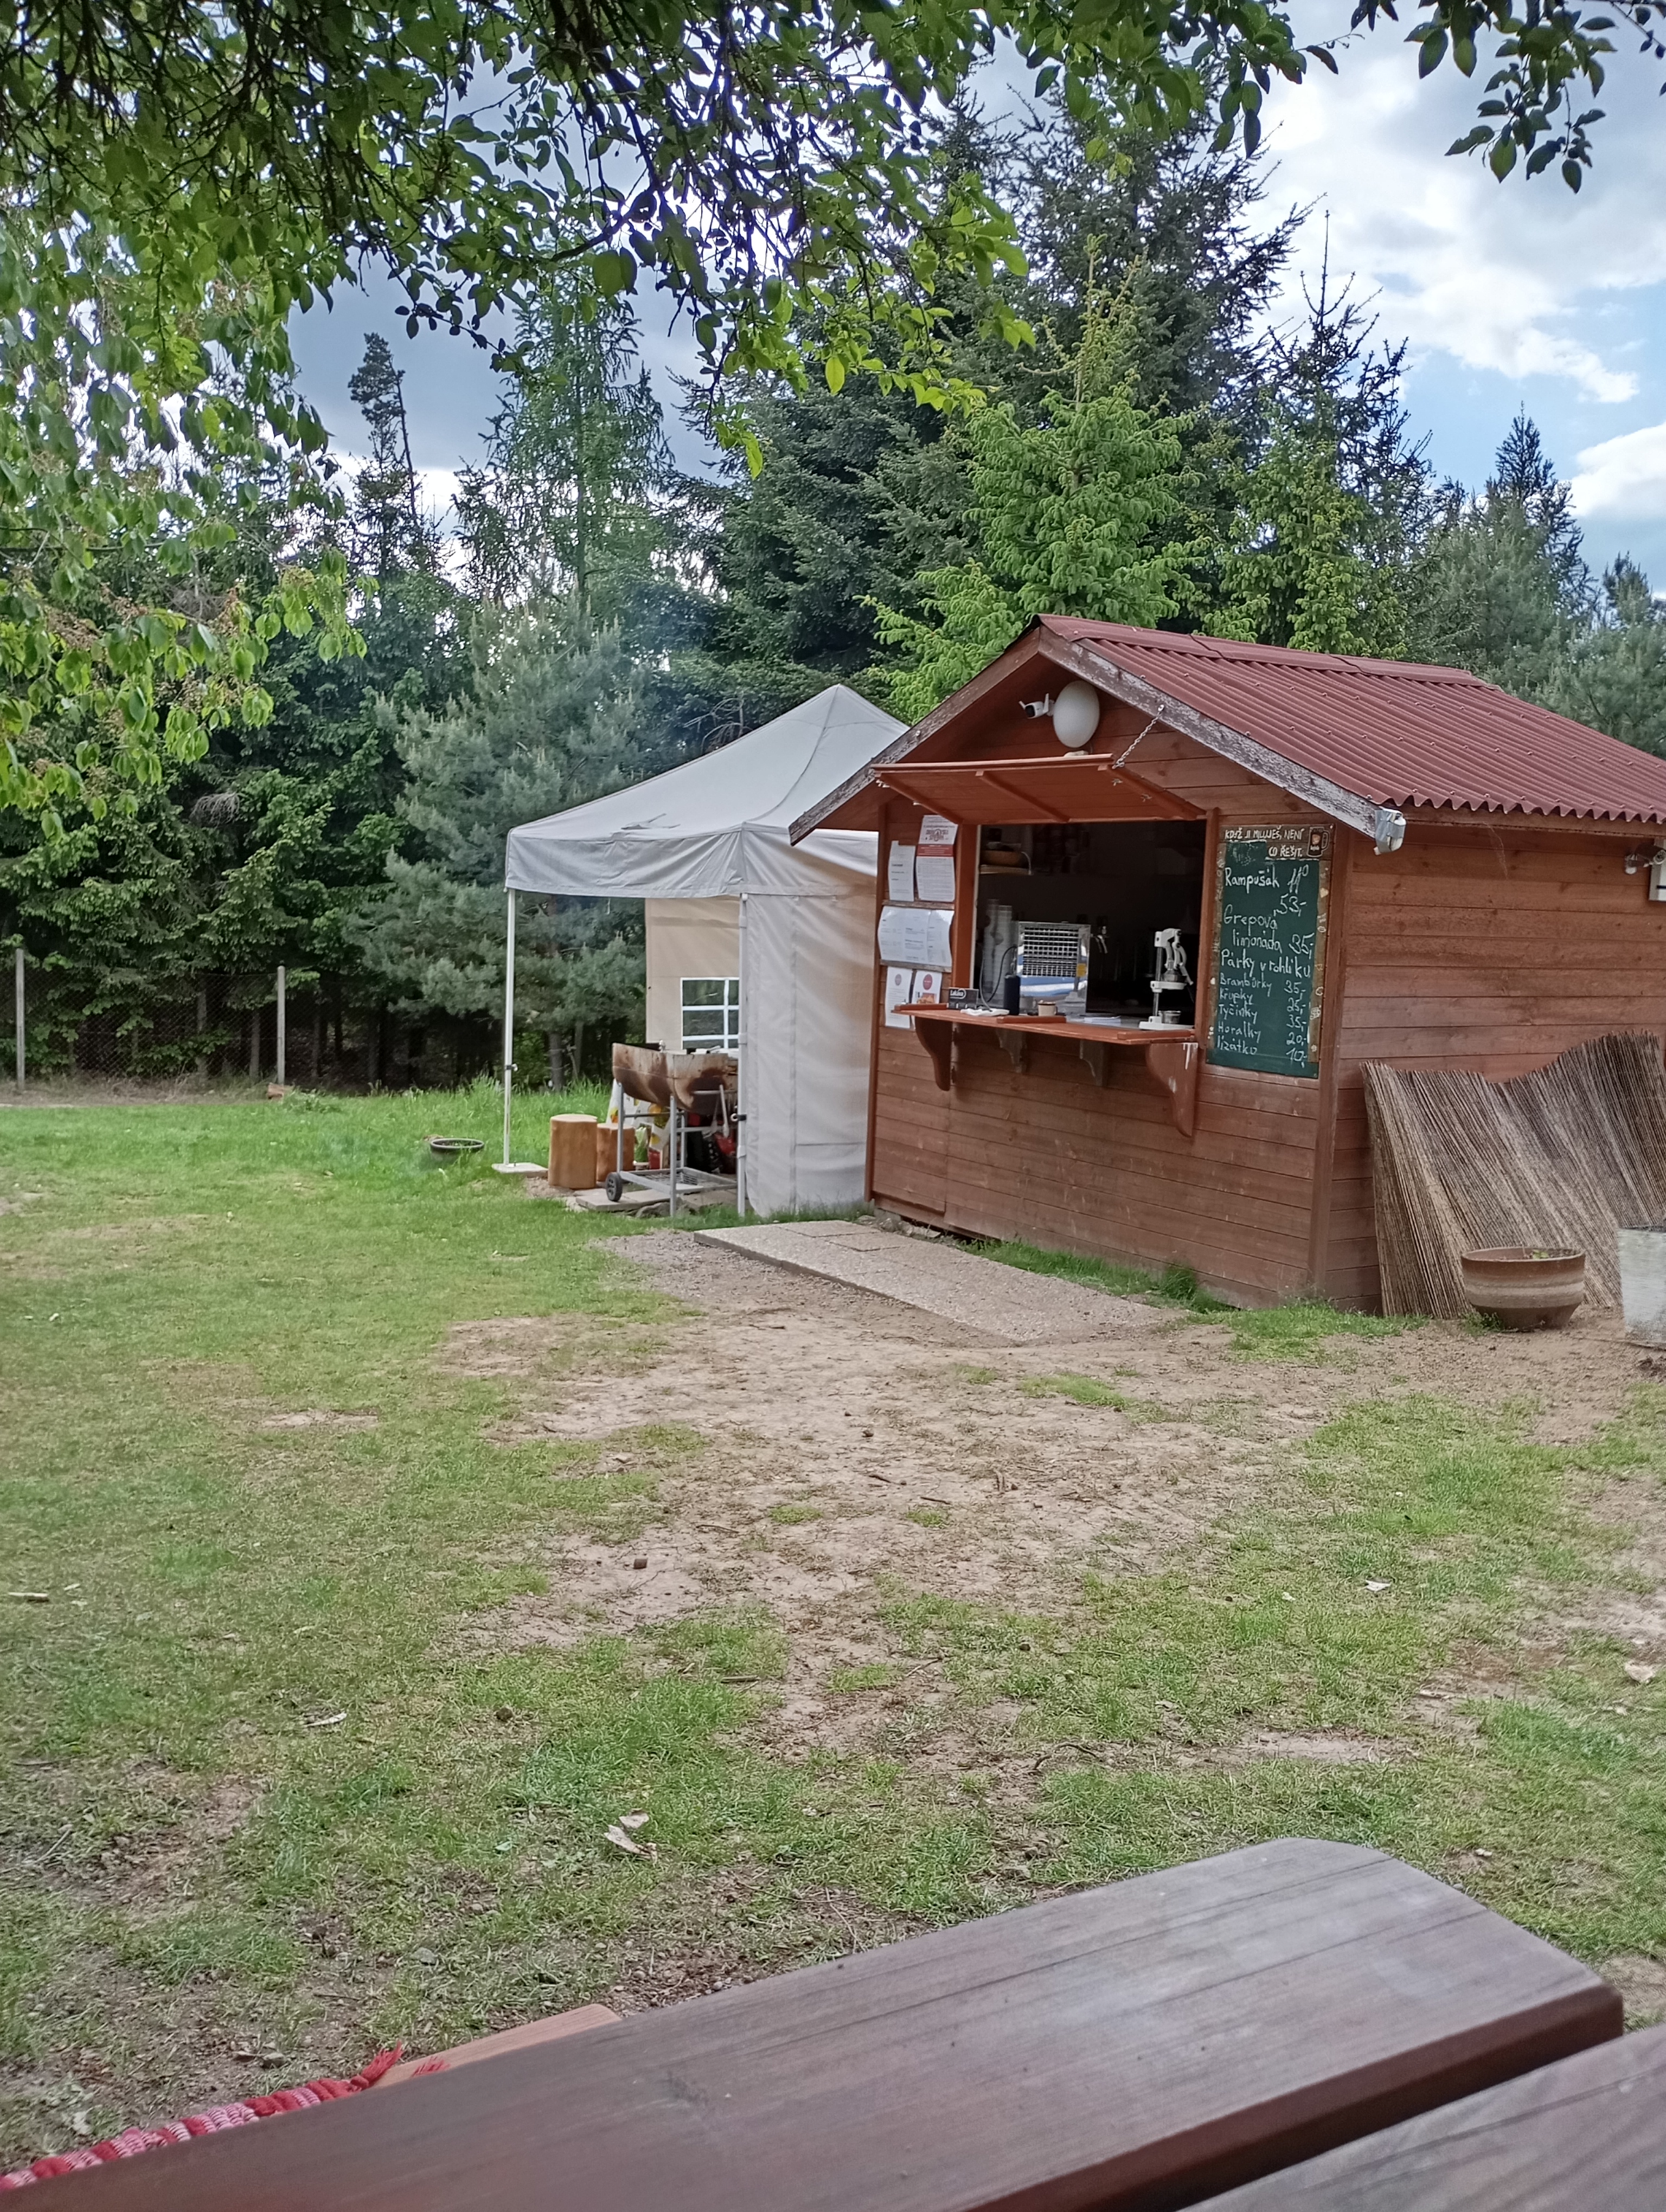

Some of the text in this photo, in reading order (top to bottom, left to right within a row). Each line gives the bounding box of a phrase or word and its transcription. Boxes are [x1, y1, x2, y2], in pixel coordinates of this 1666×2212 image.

[1284, 828, 1305, 840] NENÍ
[1268, 846, 1277, 857] CO
[1221, 948, 1254, 978] Párky
[1260, 961, 1266, 972] v
[1218, 1021, 1261, 1043] Horalky
